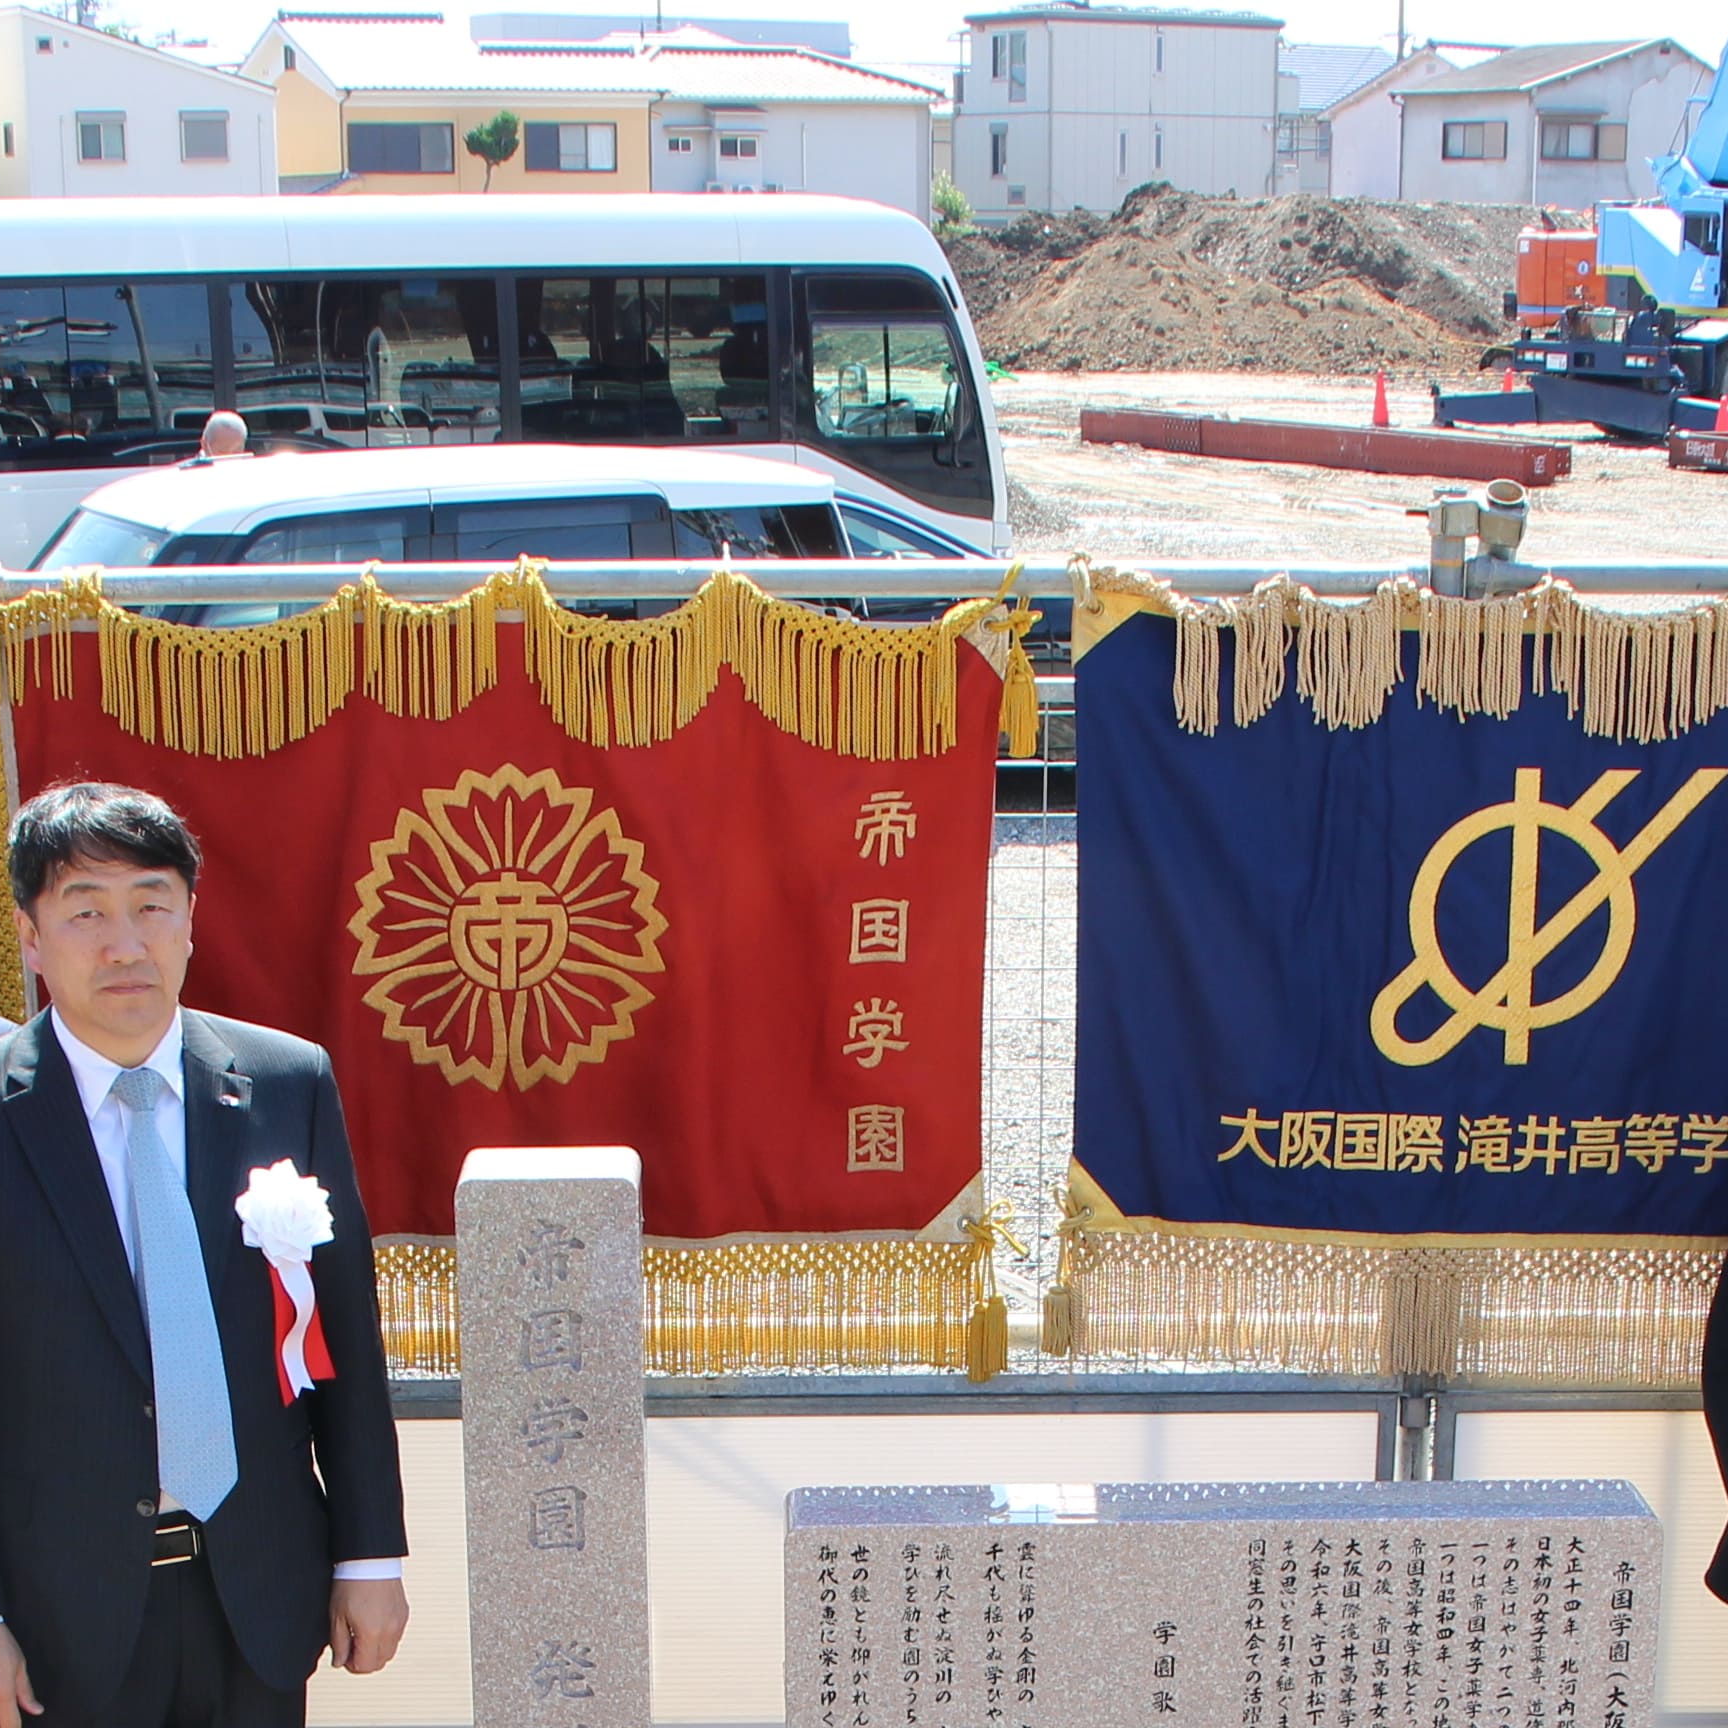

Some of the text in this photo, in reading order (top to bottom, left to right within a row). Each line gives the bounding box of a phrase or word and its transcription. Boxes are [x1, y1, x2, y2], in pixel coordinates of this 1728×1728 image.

[842, 790, 917, 1173] 帝国学園
[516, 1217, 590, 1553] 帝国学園
